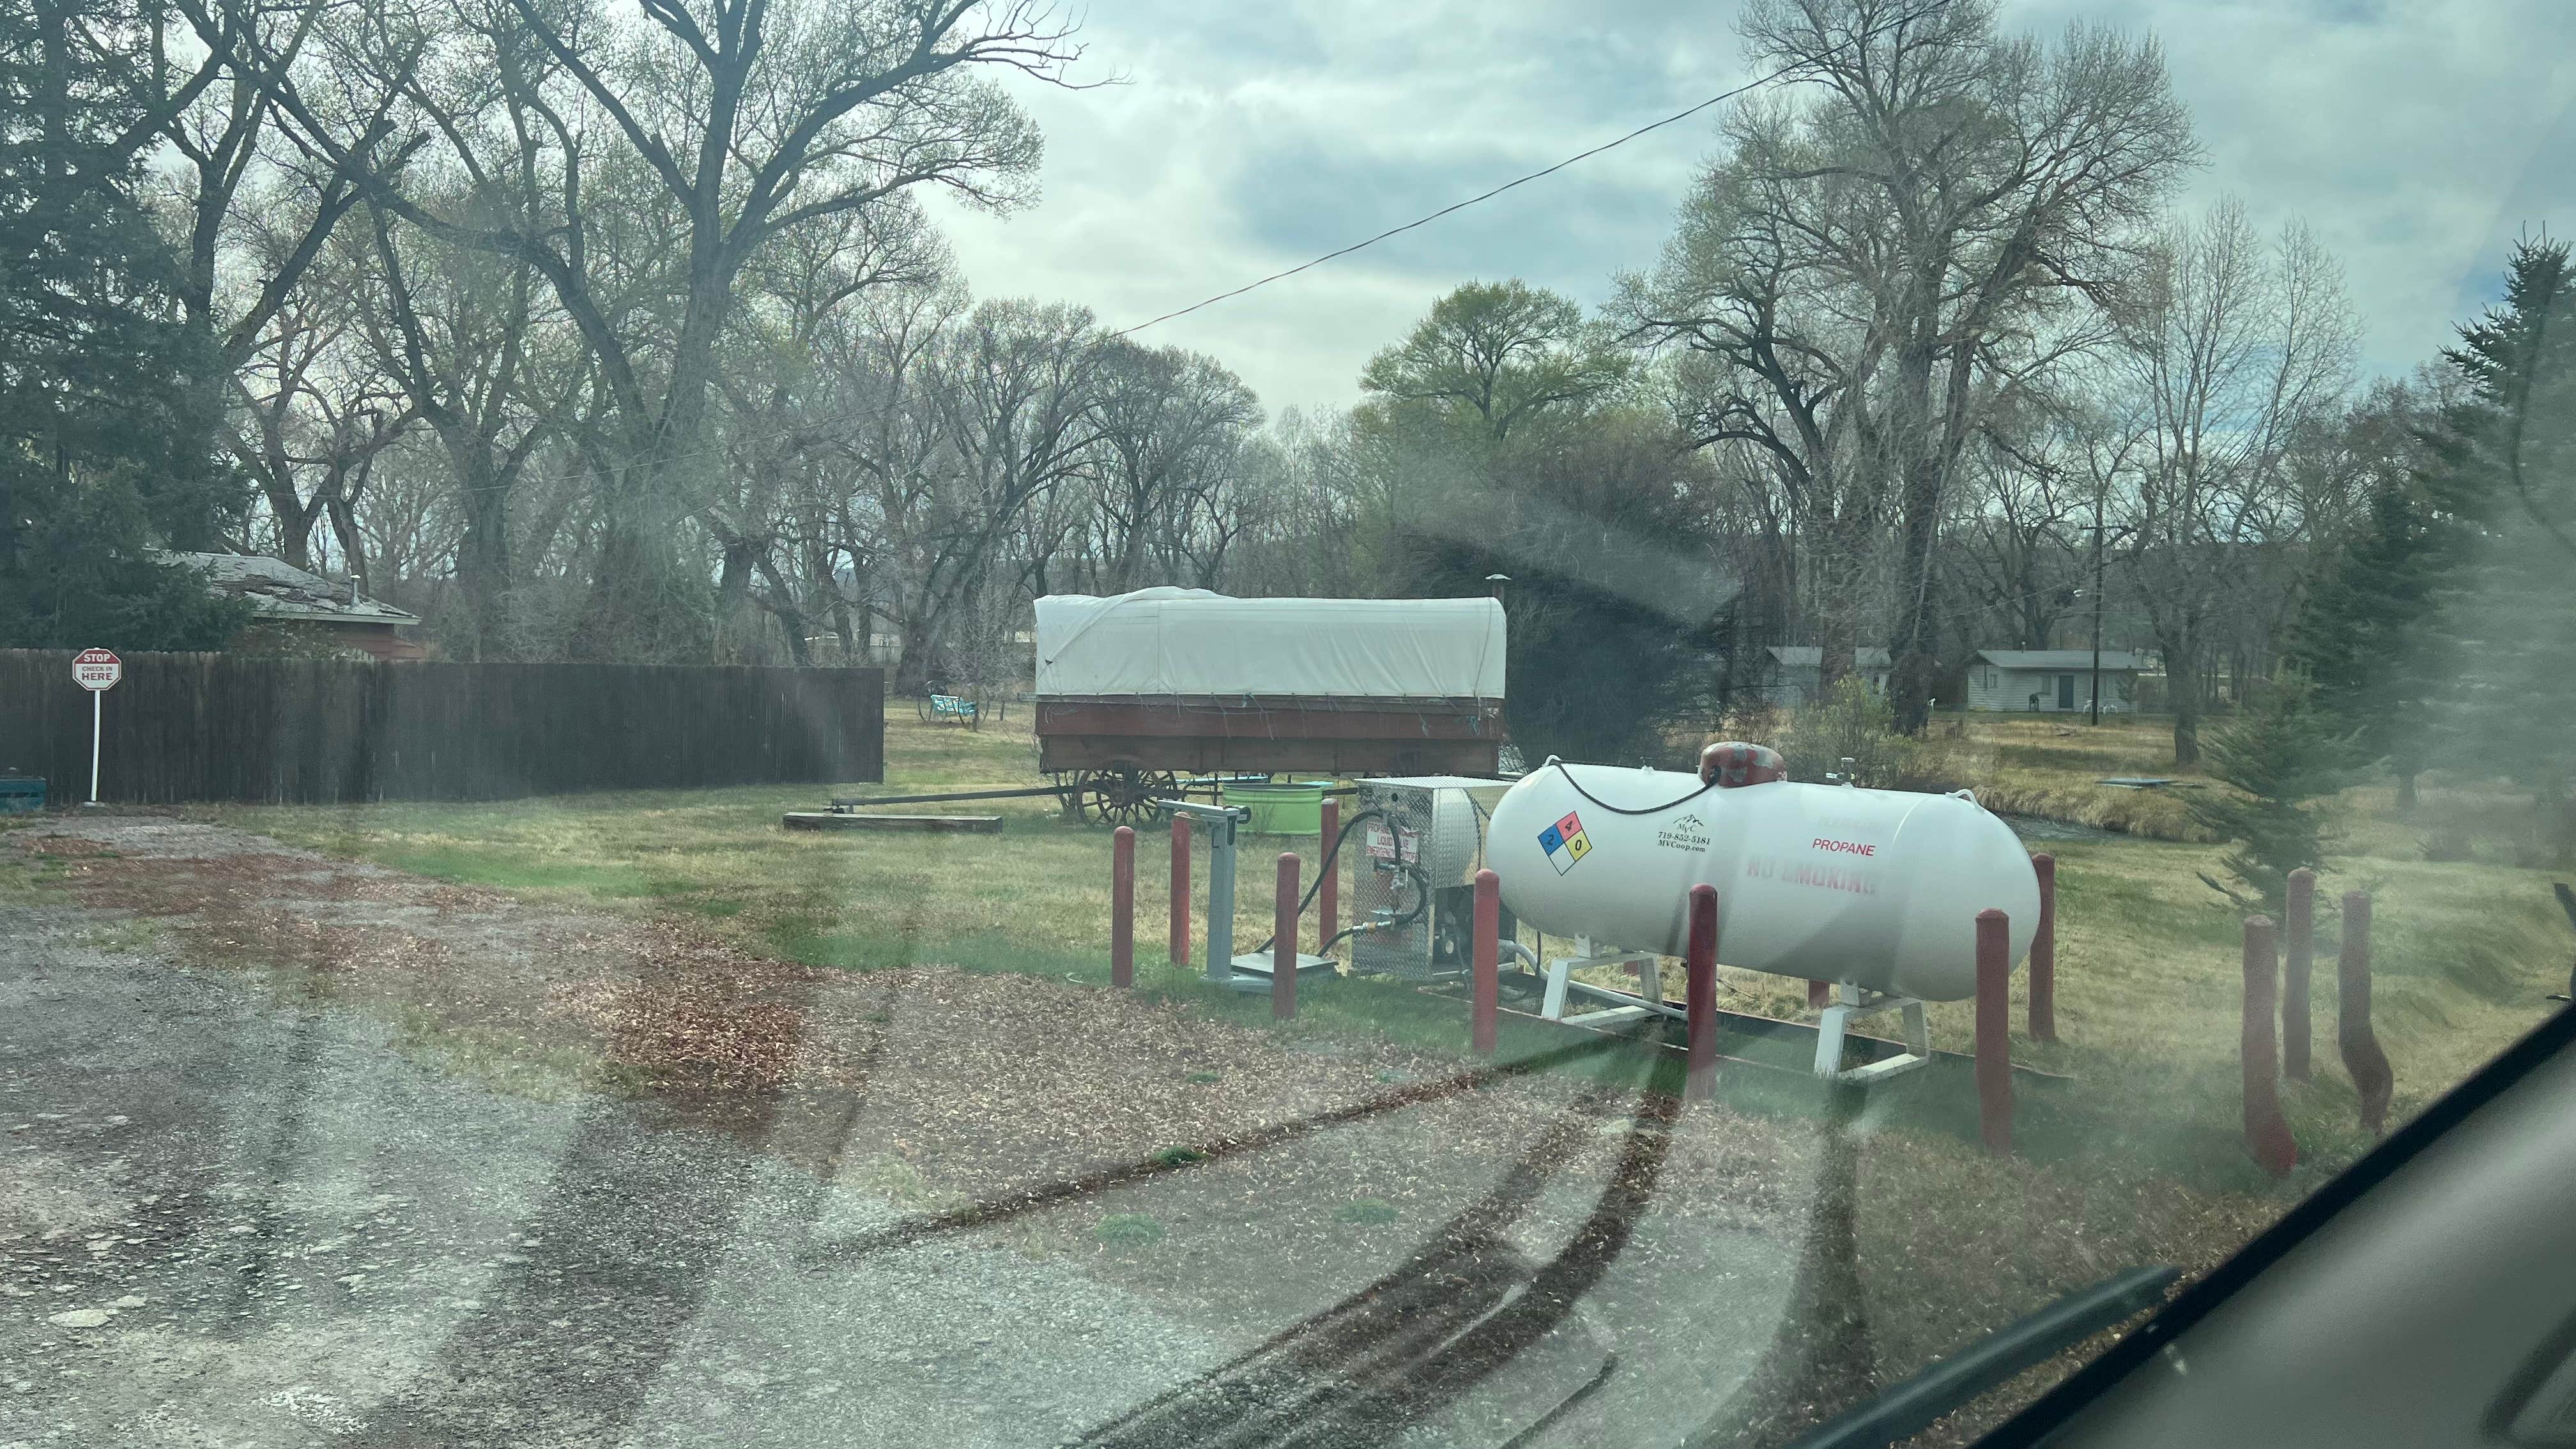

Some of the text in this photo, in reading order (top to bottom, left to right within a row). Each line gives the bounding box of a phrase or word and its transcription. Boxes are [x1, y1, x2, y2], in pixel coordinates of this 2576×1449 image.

[84, 654, 111, 662] STOP
[1565, 820, 1573, 832] 4
[1547, 834, 1554, 846] 2
[1659, 832, 1711, 845] 719-852-5181
[1575, 839, 1583, 851] 0
[1658, 839, 1705, 852] MVCoop.com
[1813, 838, 1876, 856] PROPANE
